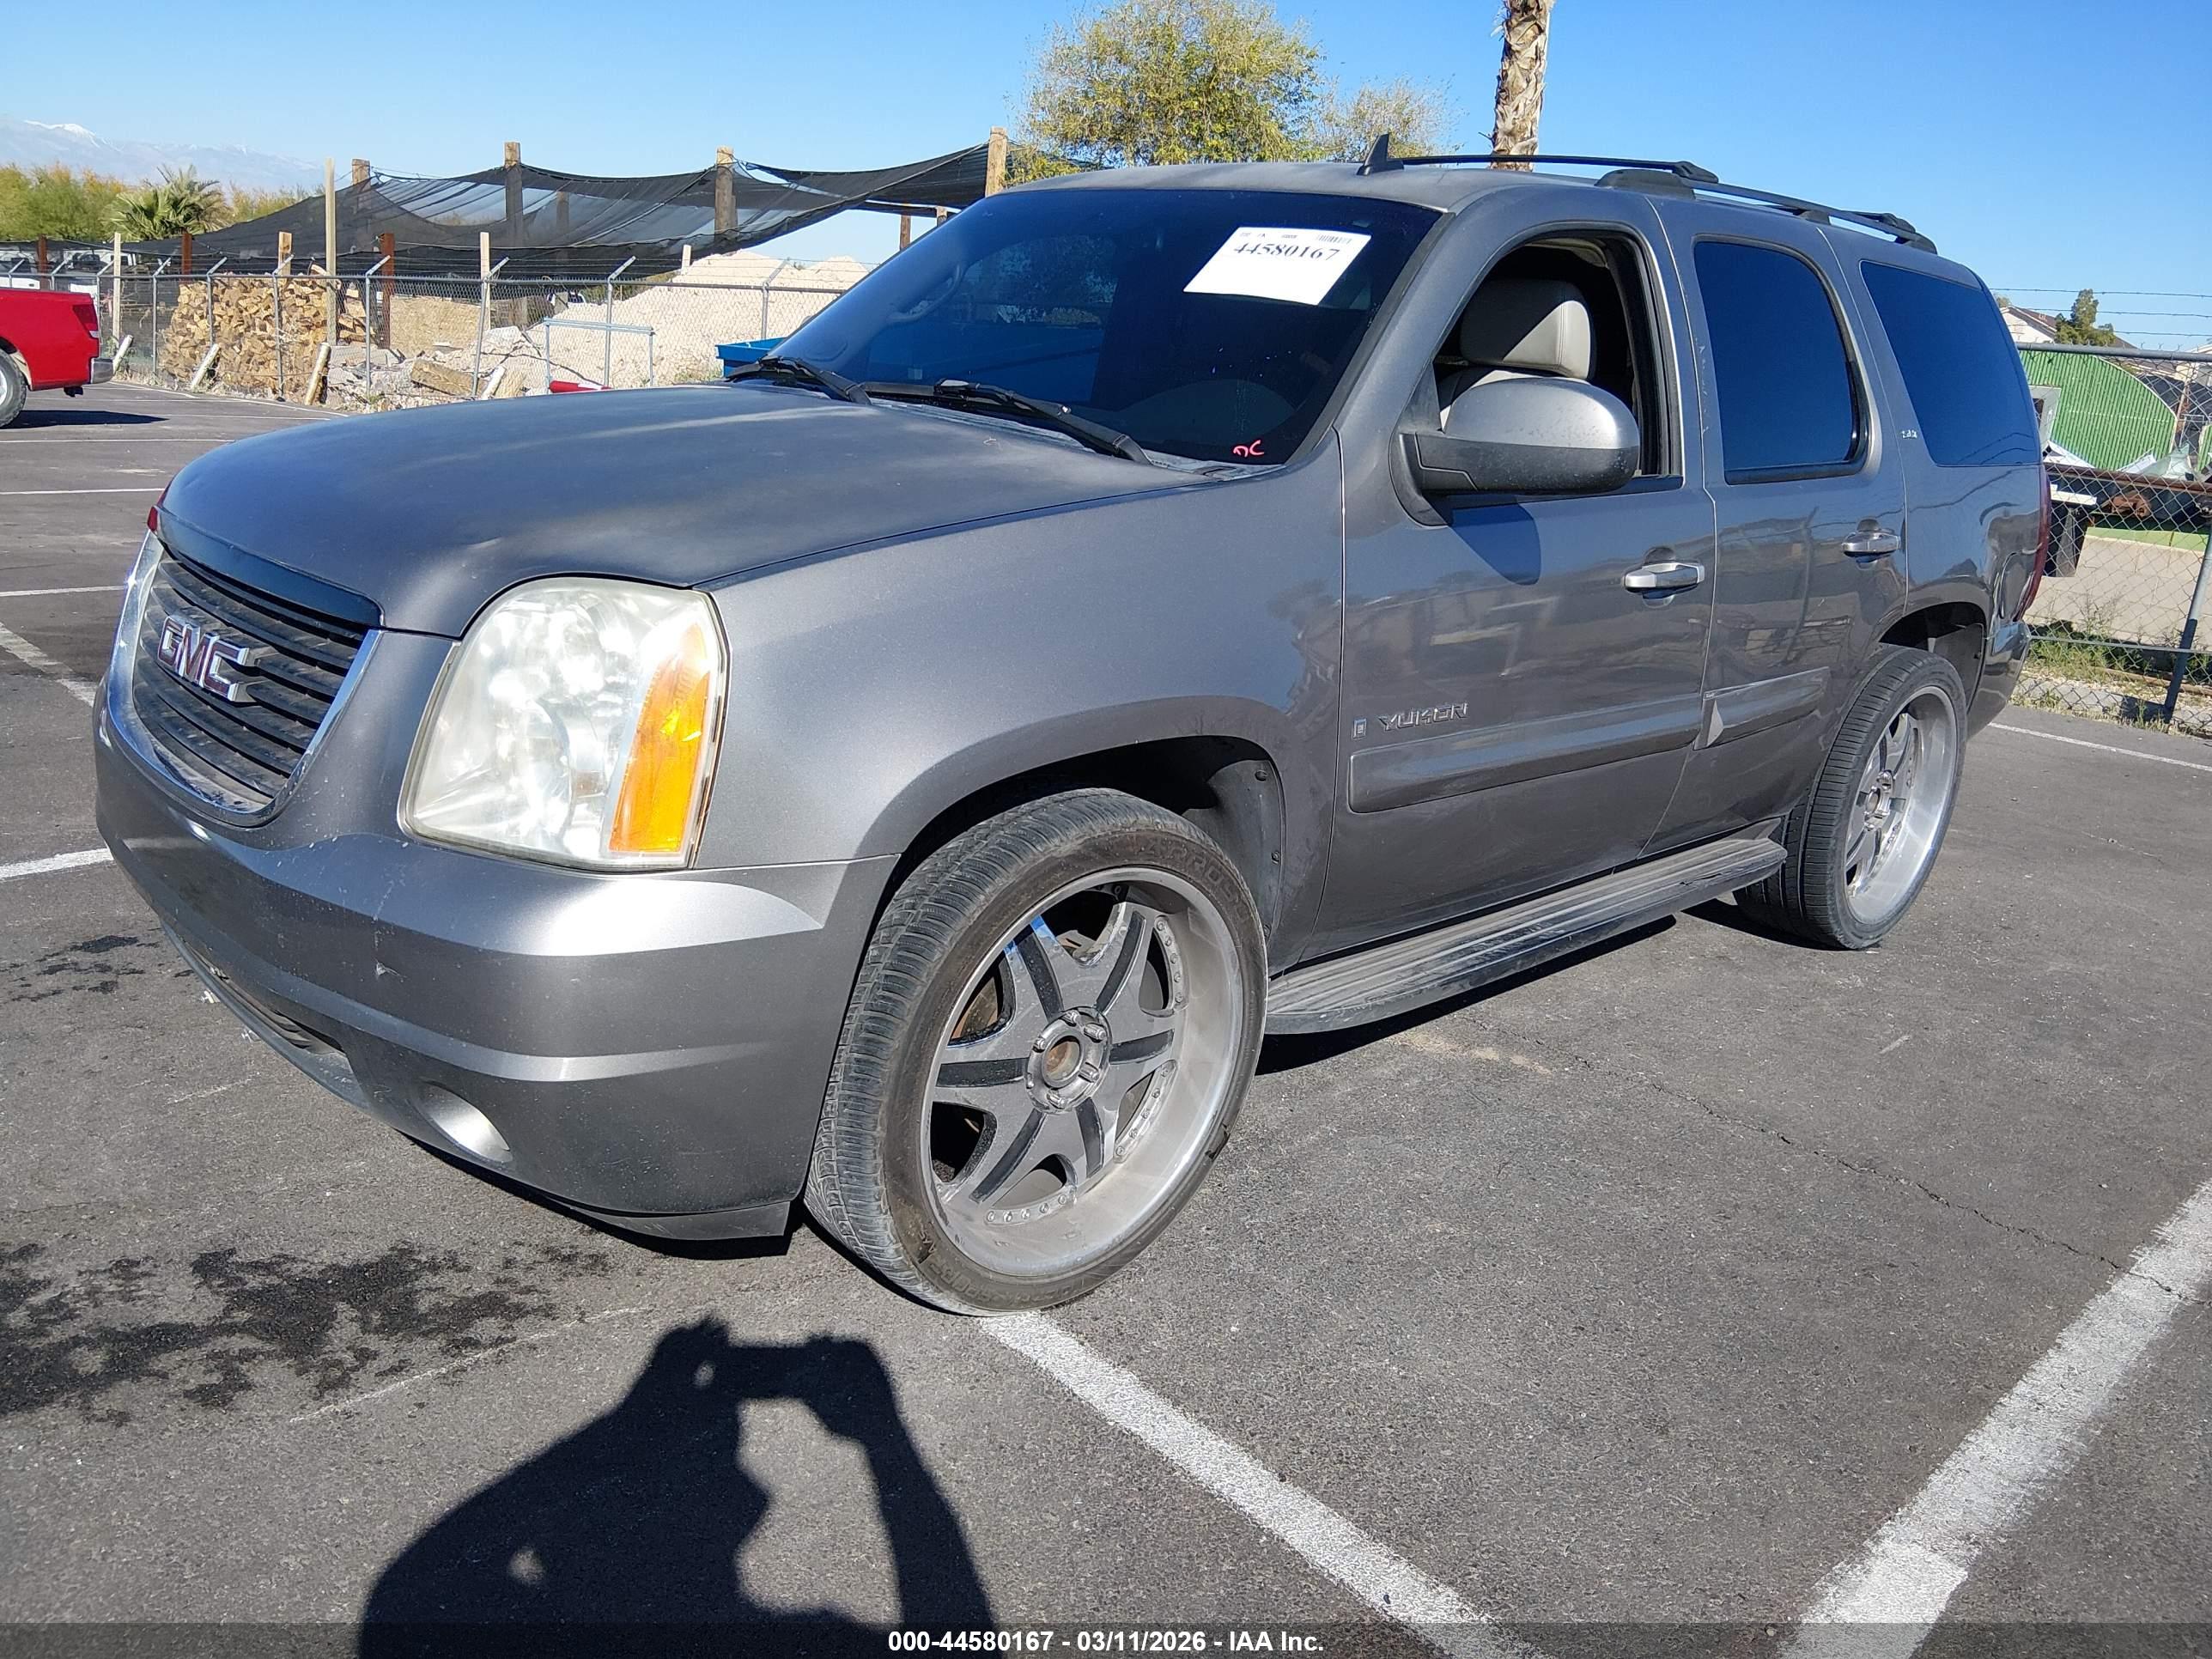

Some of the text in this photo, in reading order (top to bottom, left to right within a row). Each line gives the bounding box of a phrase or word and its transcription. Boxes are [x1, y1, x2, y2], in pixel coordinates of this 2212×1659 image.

[1233, 242, 1340, 260] 44580167
[158, 615, 250, 702] GMC
[1378, 702, 1468, 732] YUKON
